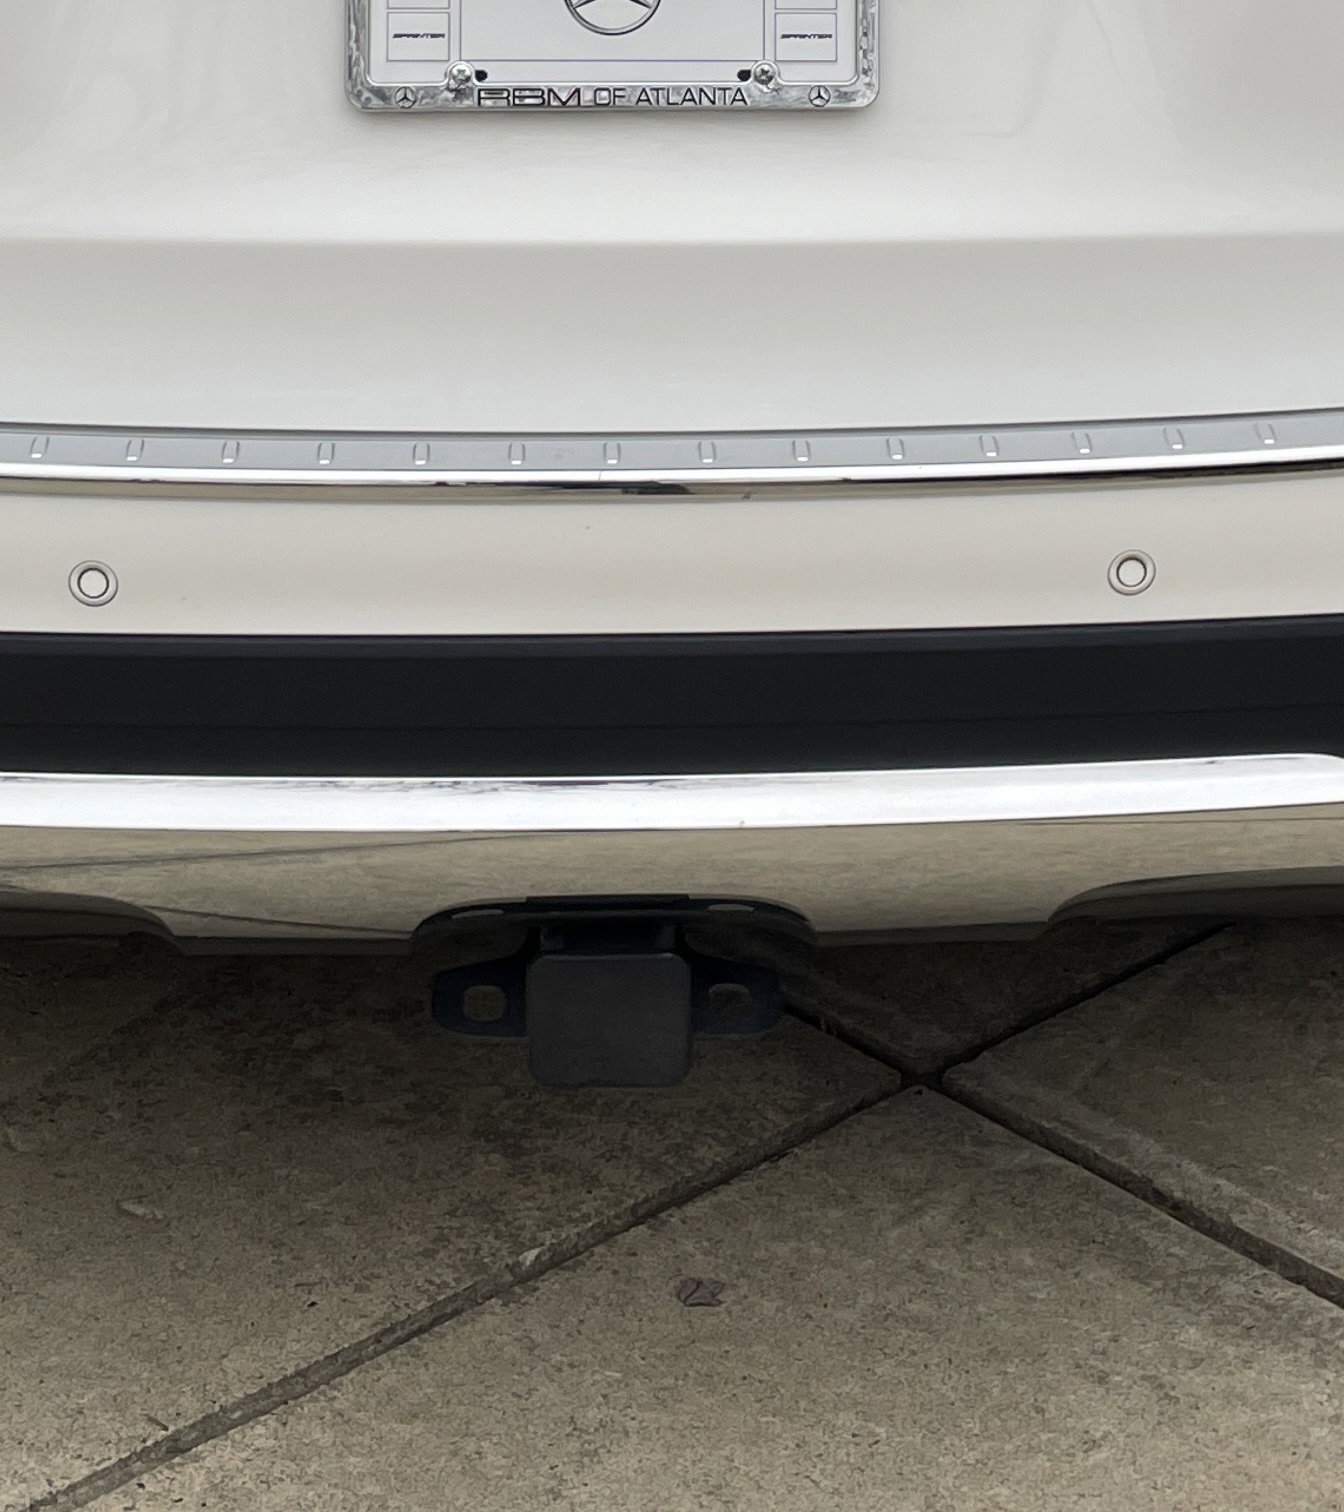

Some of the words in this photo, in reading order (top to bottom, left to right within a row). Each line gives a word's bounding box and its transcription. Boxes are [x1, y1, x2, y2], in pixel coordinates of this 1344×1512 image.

[477, 87, 582, 107] RBM
[593, 87, 627, 106] OF
[635, 87, 749, 106] ATLANTA
